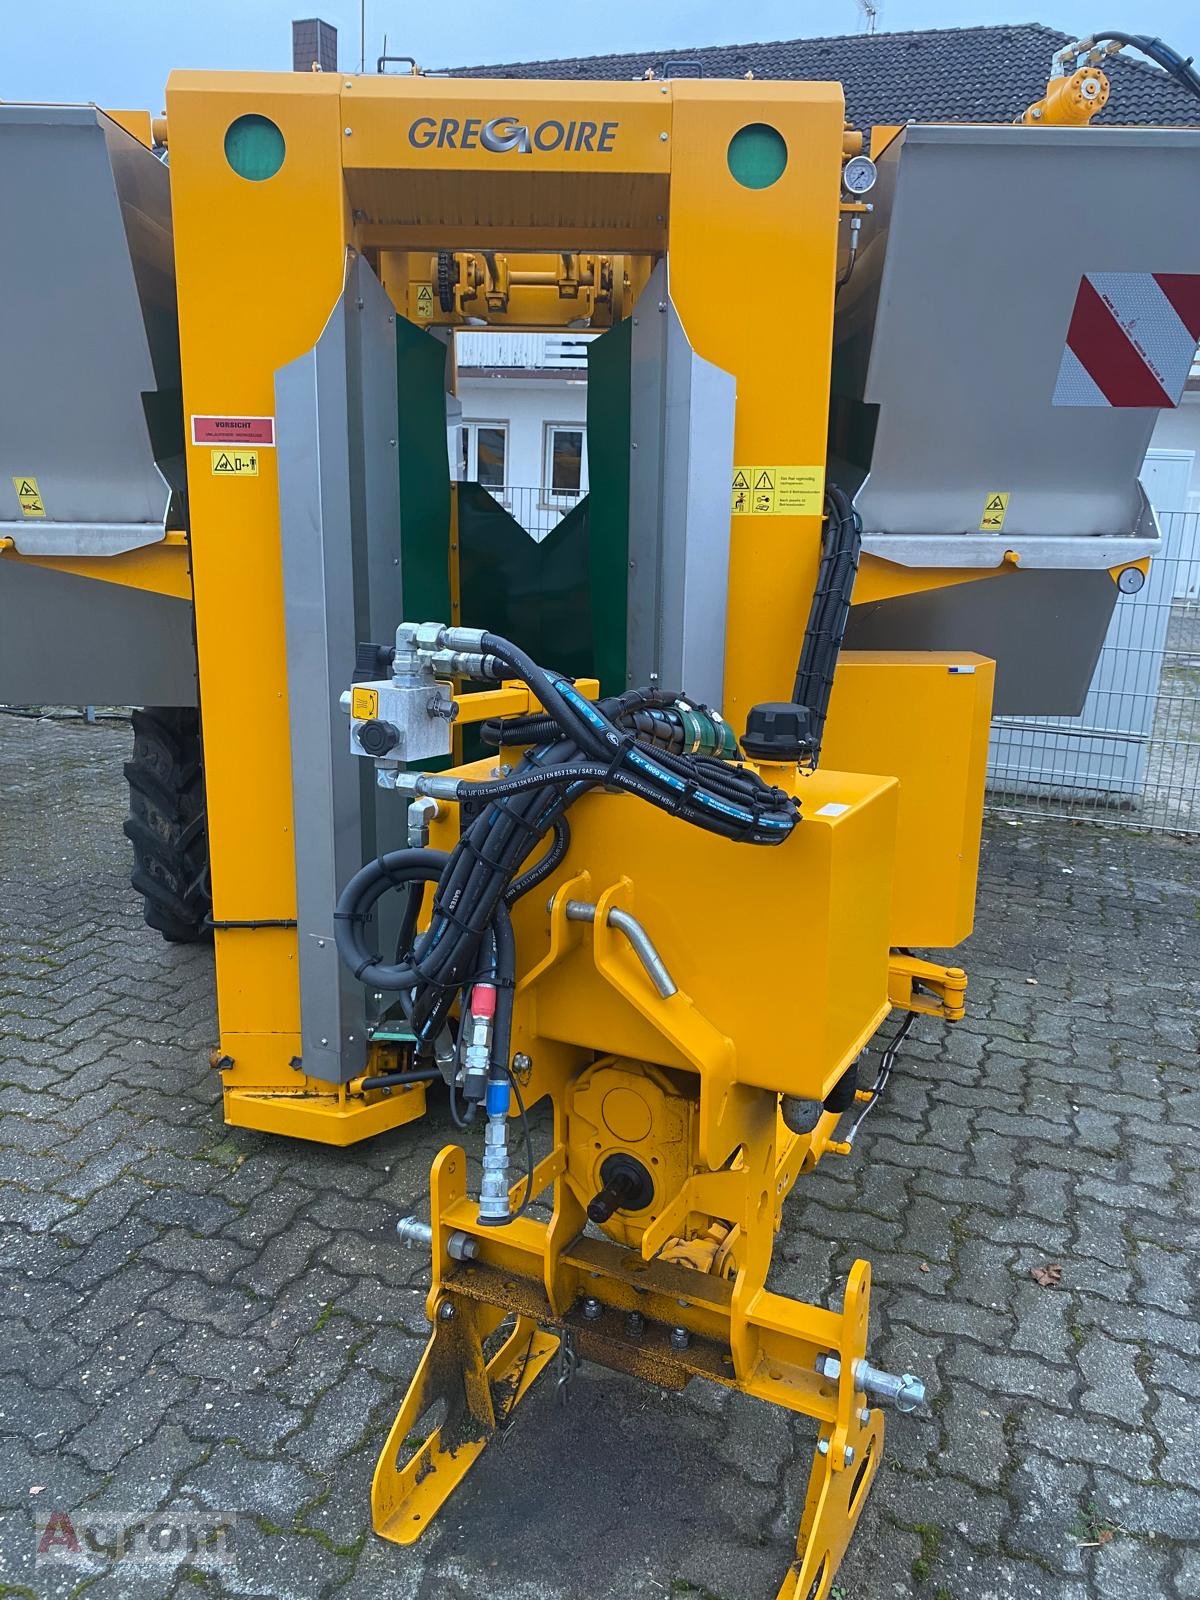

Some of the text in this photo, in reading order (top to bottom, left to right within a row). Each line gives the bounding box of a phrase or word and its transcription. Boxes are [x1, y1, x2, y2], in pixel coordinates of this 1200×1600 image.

[408, 117, 619, 154] GREGOIRE
[215, 421, 252, 429] VORSICHT
[644, 761, 661, 776] 4000
